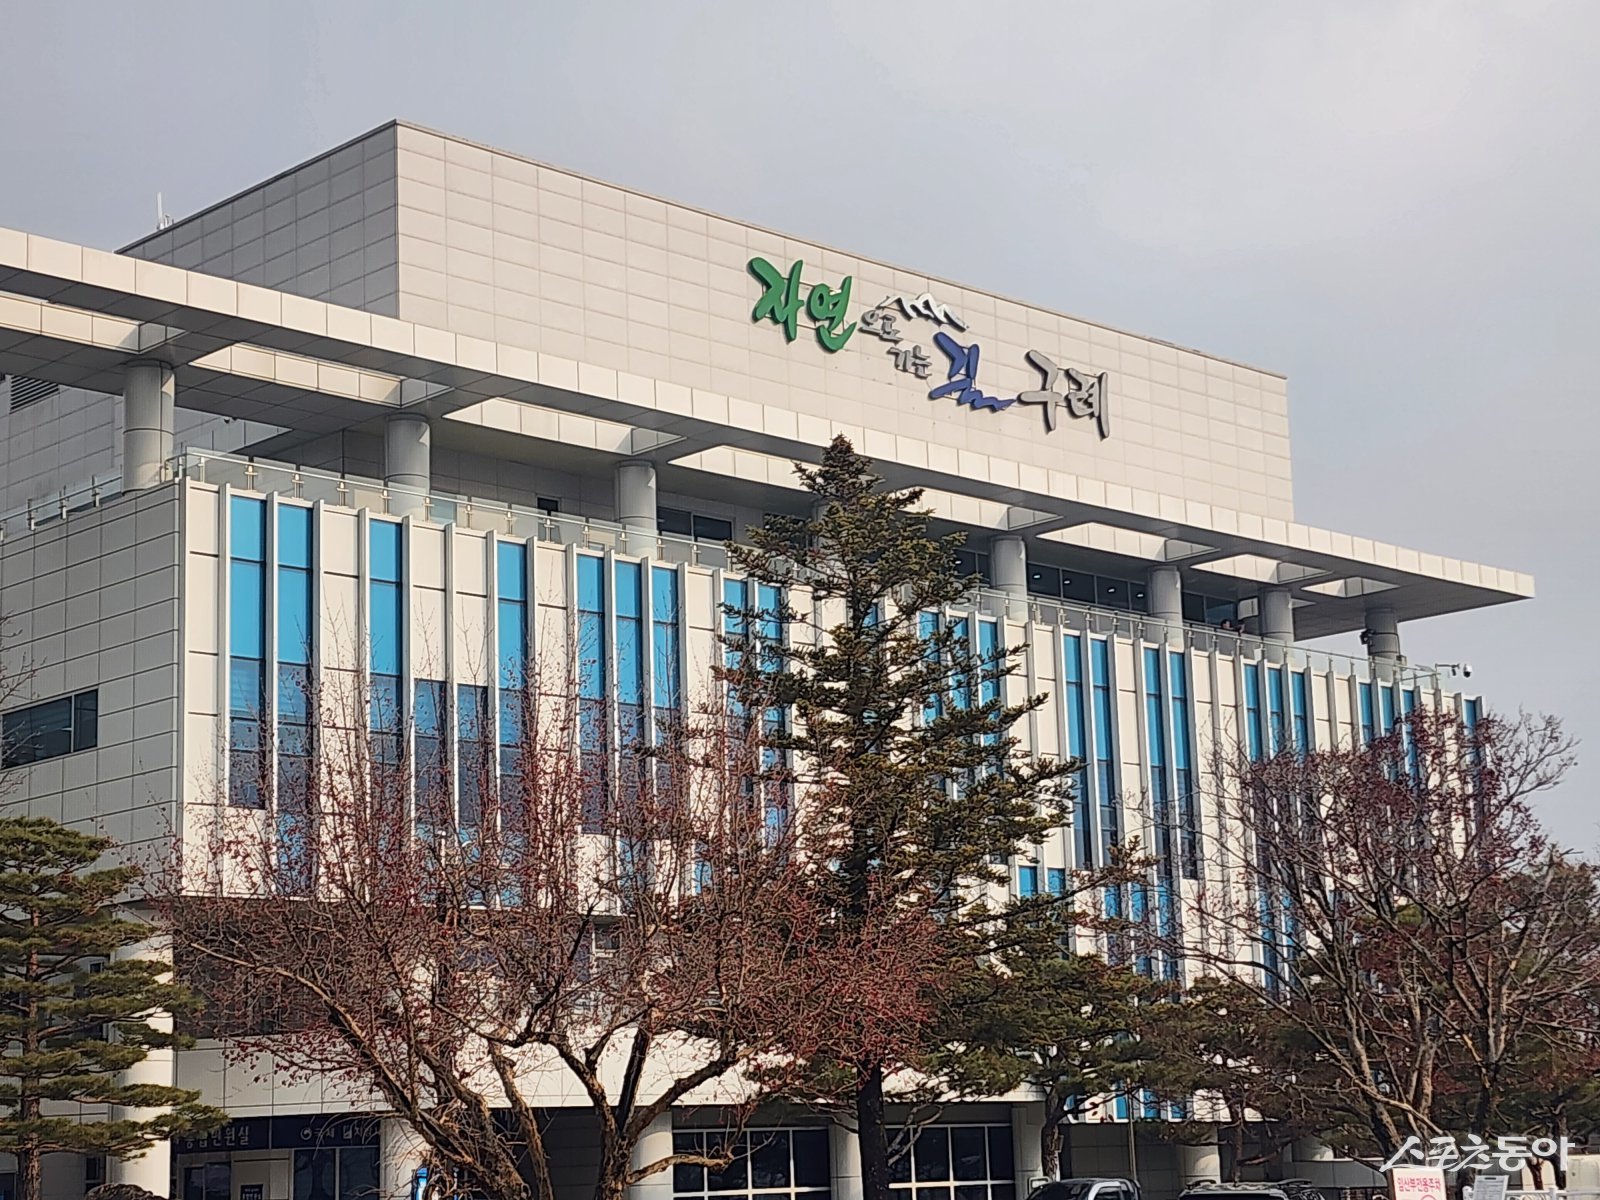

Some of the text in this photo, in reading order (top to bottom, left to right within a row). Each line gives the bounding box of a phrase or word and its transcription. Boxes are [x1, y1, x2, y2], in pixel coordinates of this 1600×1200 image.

[747, 257, 1109, 438] 자연 으로 가는 길 구례
